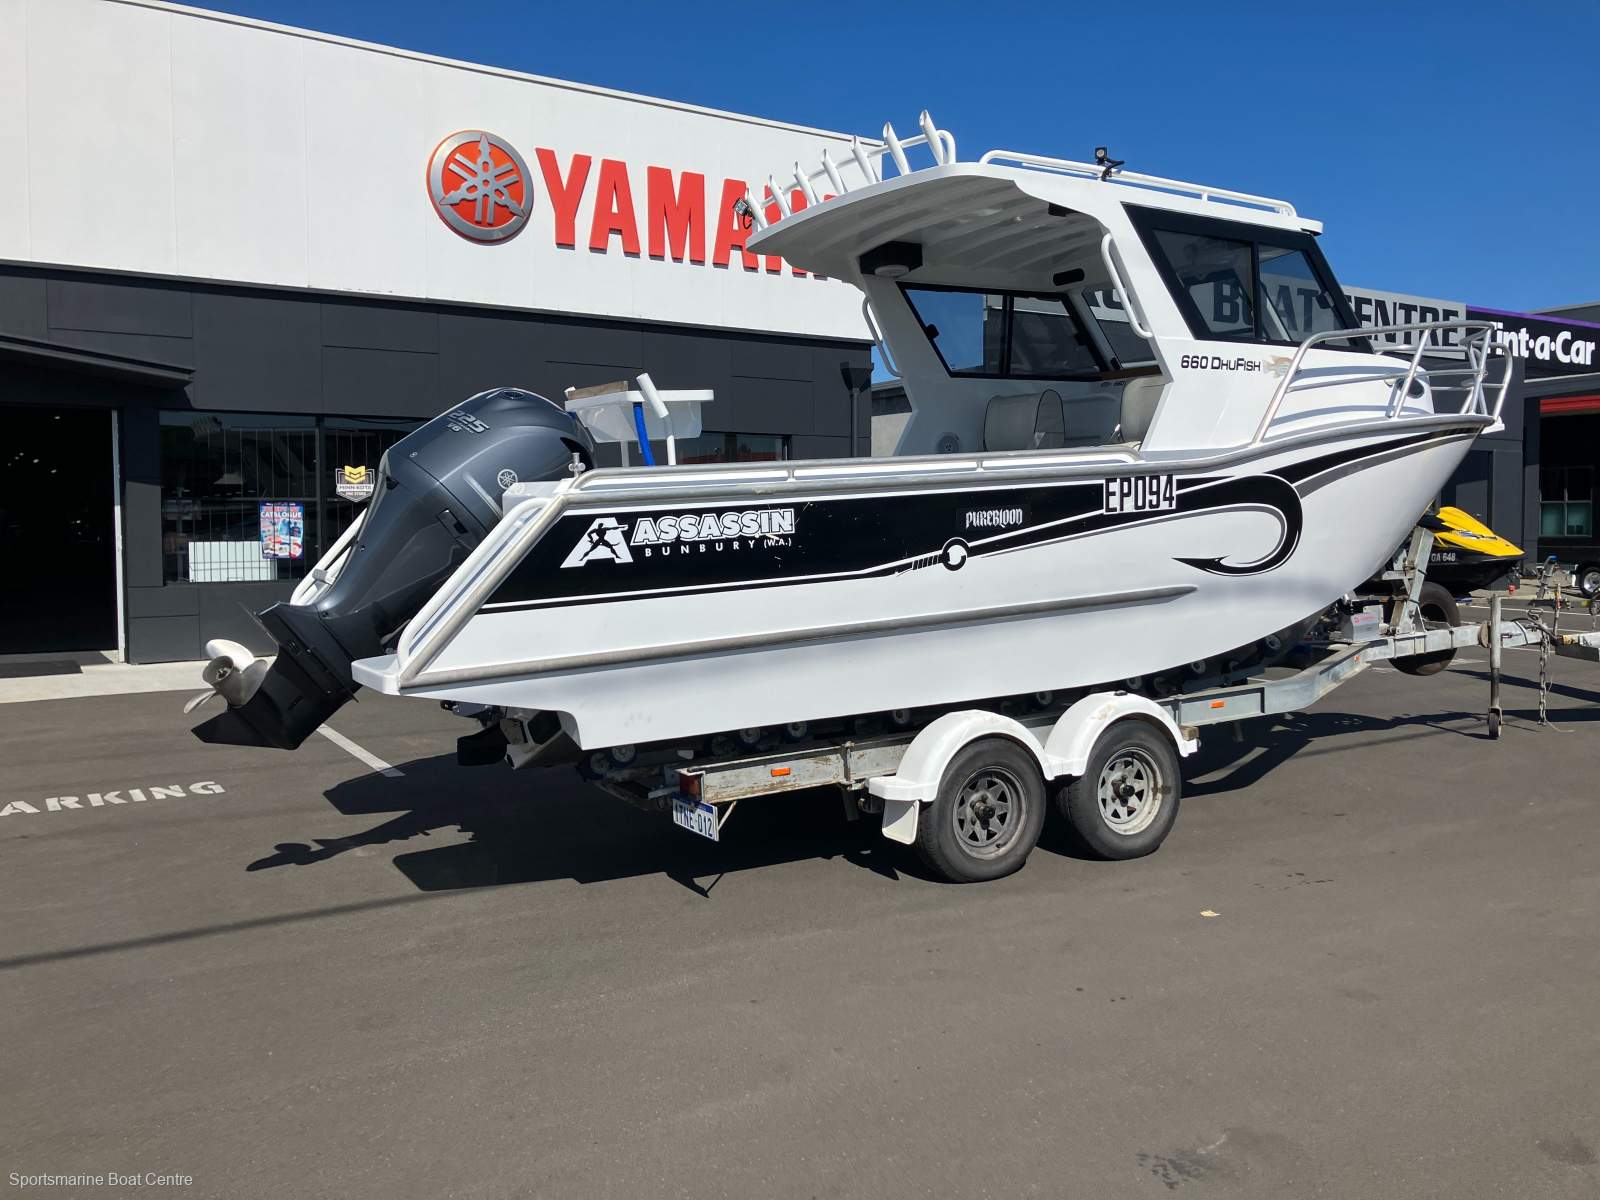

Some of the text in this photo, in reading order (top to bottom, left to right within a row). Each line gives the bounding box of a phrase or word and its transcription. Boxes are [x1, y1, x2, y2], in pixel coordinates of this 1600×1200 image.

[535, 147, 840, 281] YAMA
[1334, 294, 1459, 347] ENTRE
[1181, 355, 1208, 369] 660
[448, 410, 490, 433] 225
[1104, 474, 1175, 513] EP094
[630, 508, 795, 545] ASSASSIN
[645, 540, 755, 557] BUNBURY
